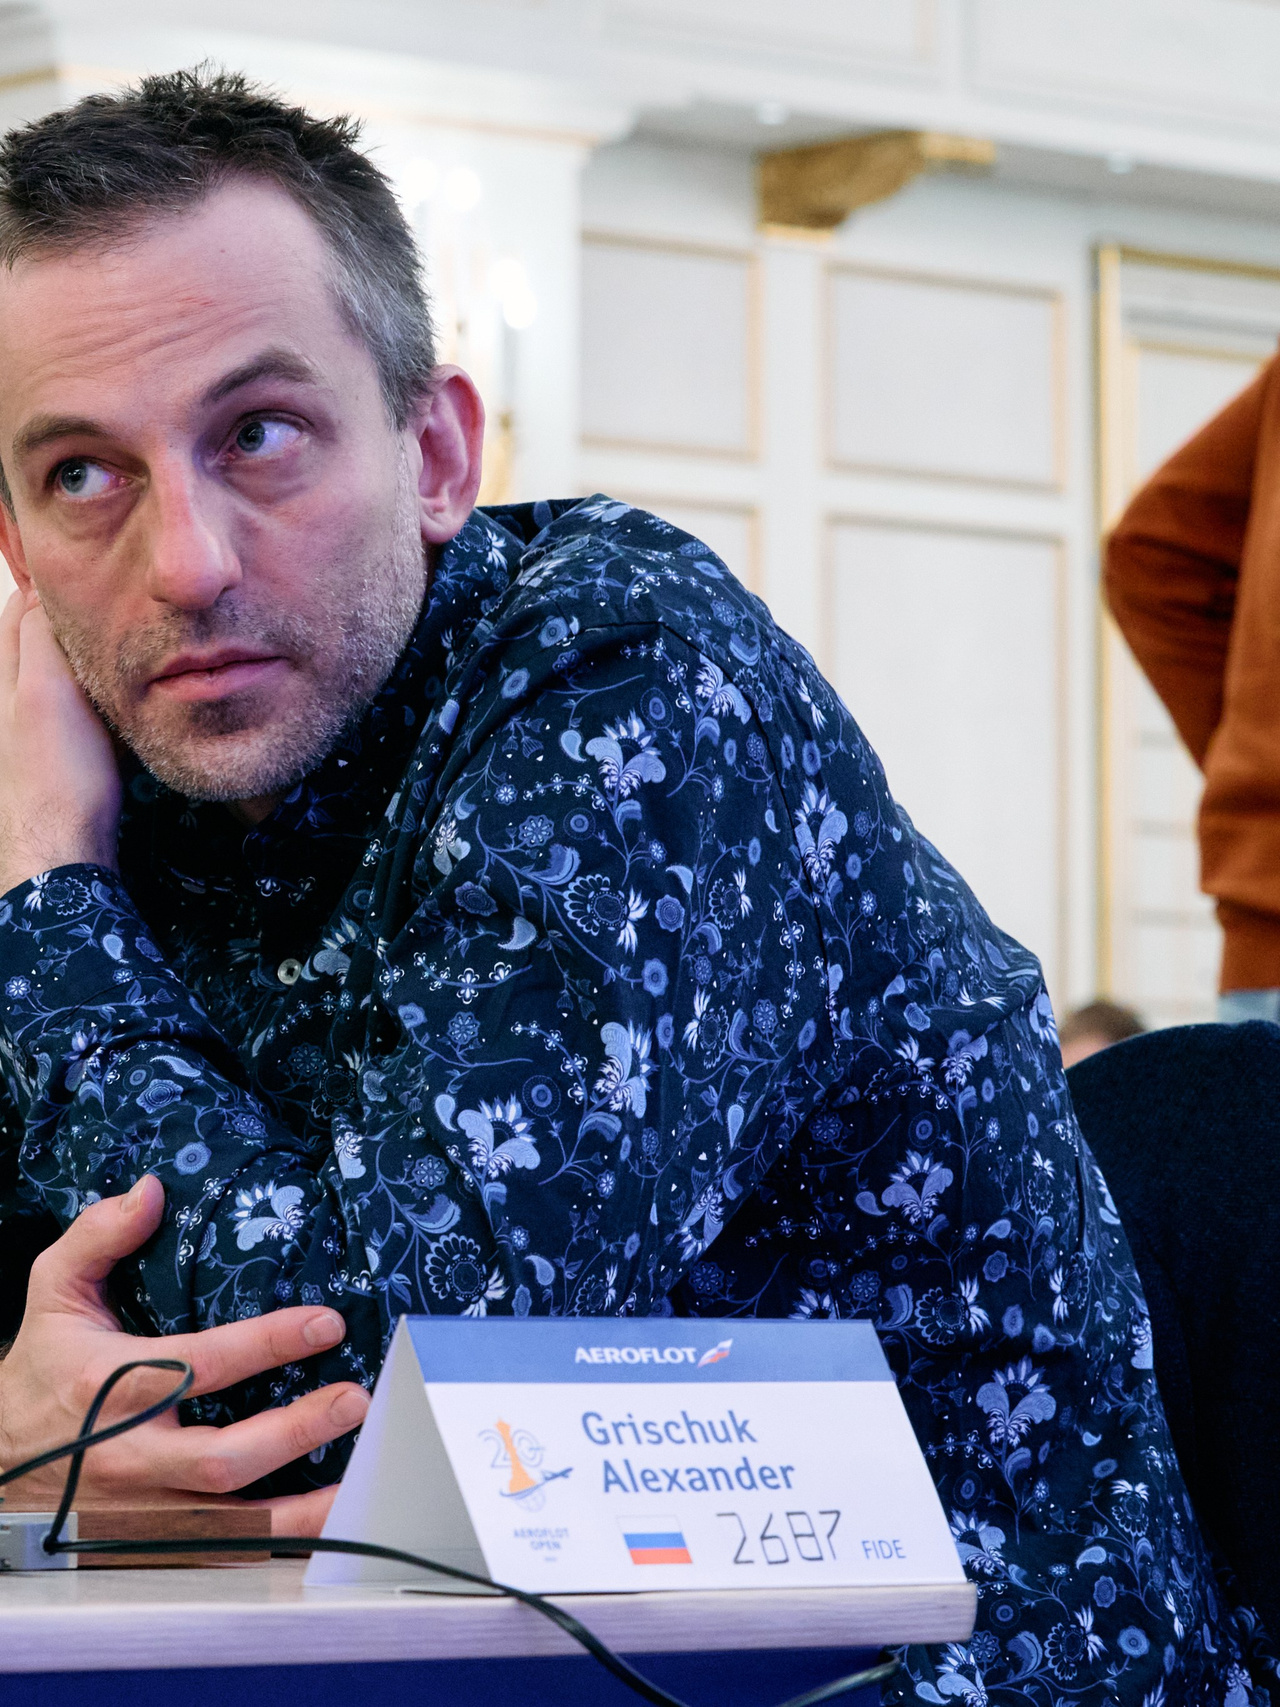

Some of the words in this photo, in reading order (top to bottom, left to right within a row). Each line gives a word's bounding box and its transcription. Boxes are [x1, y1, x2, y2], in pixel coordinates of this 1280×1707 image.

[575, 1347, 697, 1364] AEROFLOT
[581, 1409, 758, 1446] Grischuk
[602, 1456, 795, 1494] Alexander
[716, 1510, 841, 1565] 2687
[861, 1539, 907, 1560] FIDE
